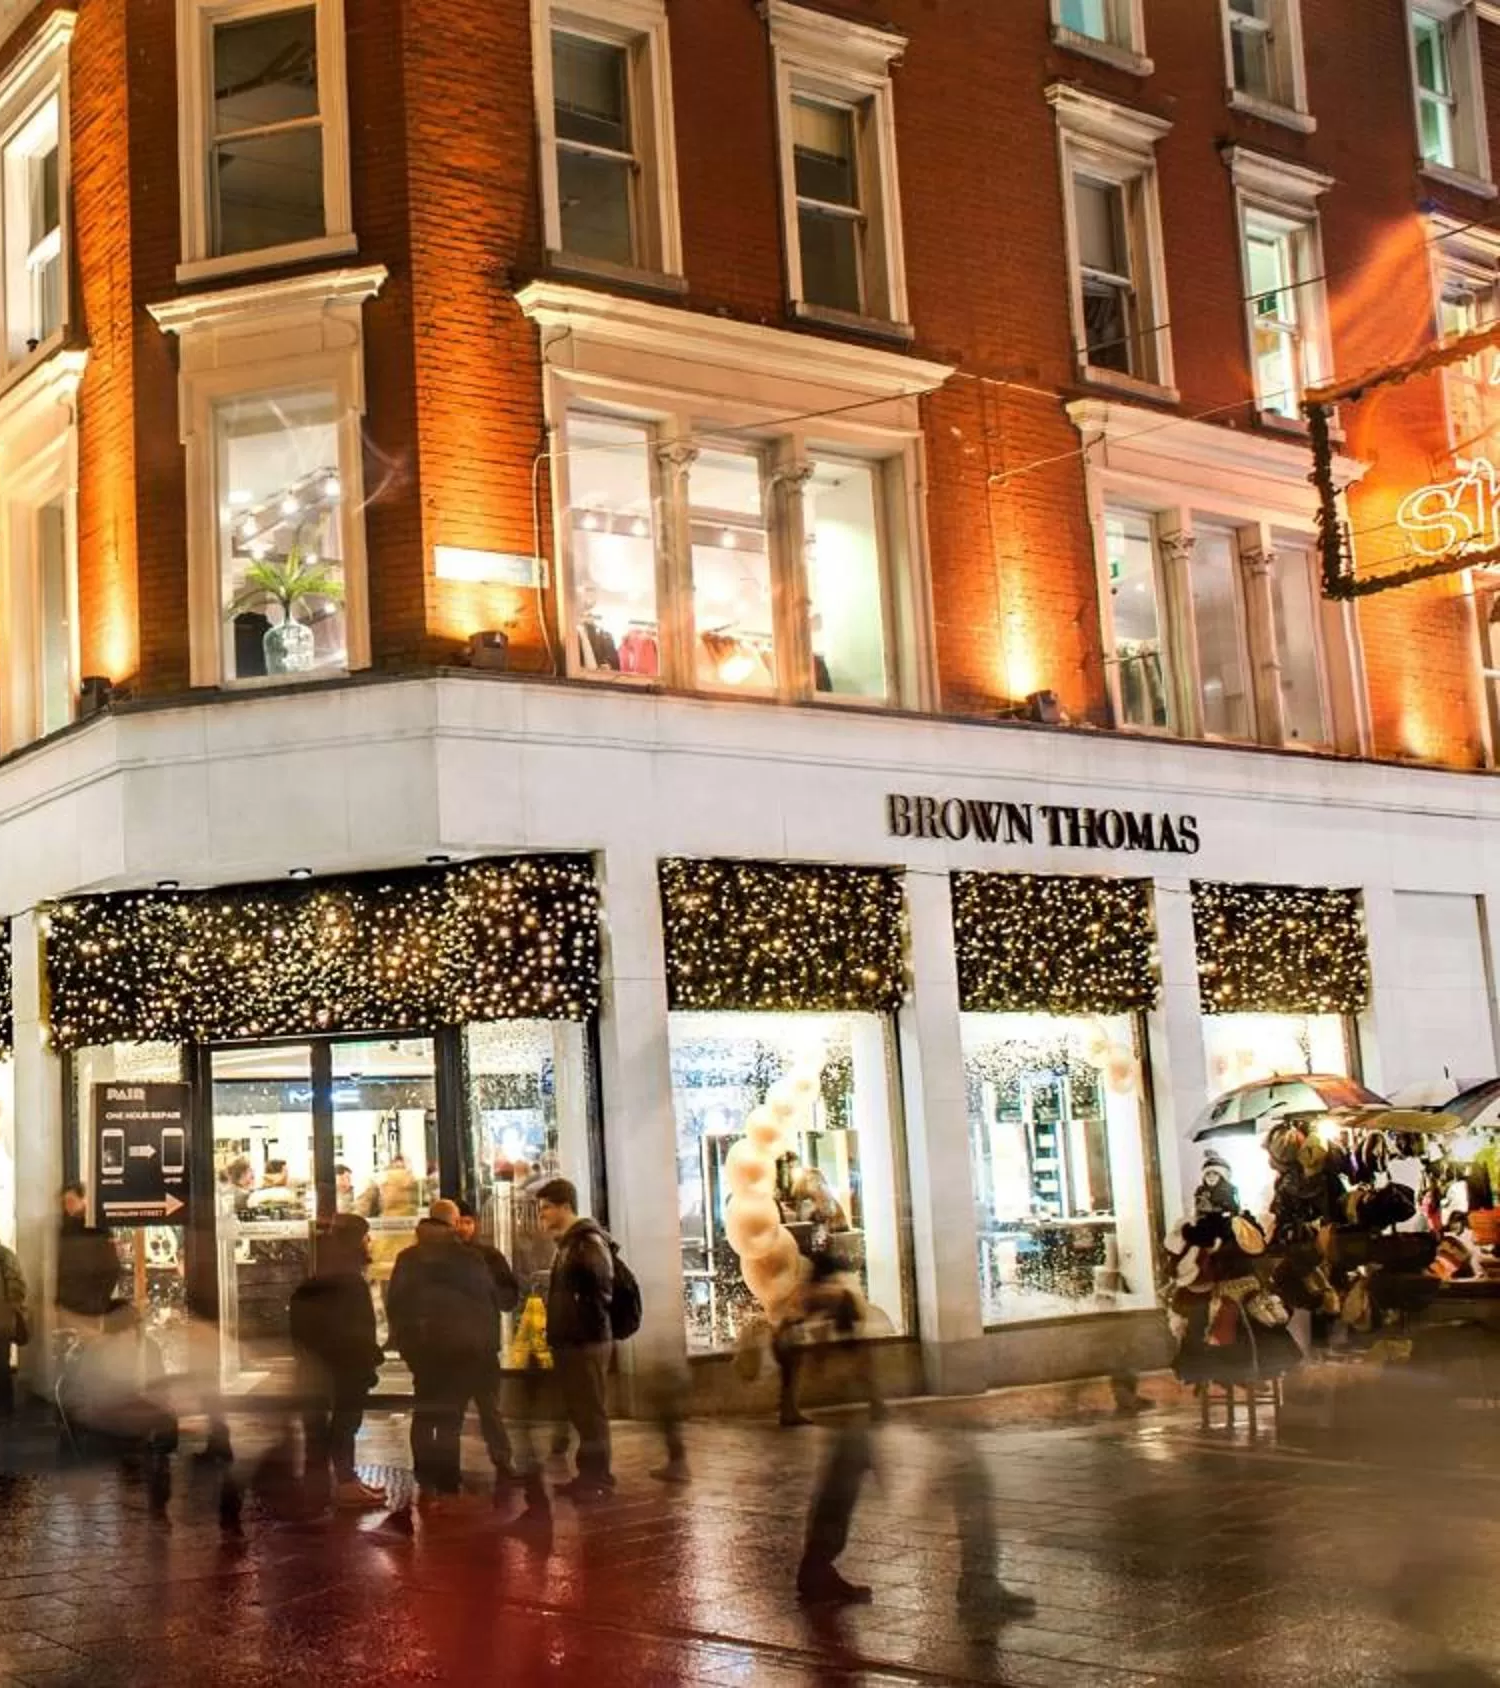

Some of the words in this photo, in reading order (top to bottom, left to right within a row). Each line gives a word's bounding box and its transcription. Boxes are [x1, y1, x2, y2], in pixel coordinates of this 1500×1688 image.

[886, 794, 1035, 844] BROWN
[1040, 806, 1199, 854] THOMAS
[289, 1088, 360, 1104] MC
[105, 1111, 124, 1120] ONE
[125, 1111, 149, 1120] HOUR
[151, 1111, 181, 1119] REPAIR
